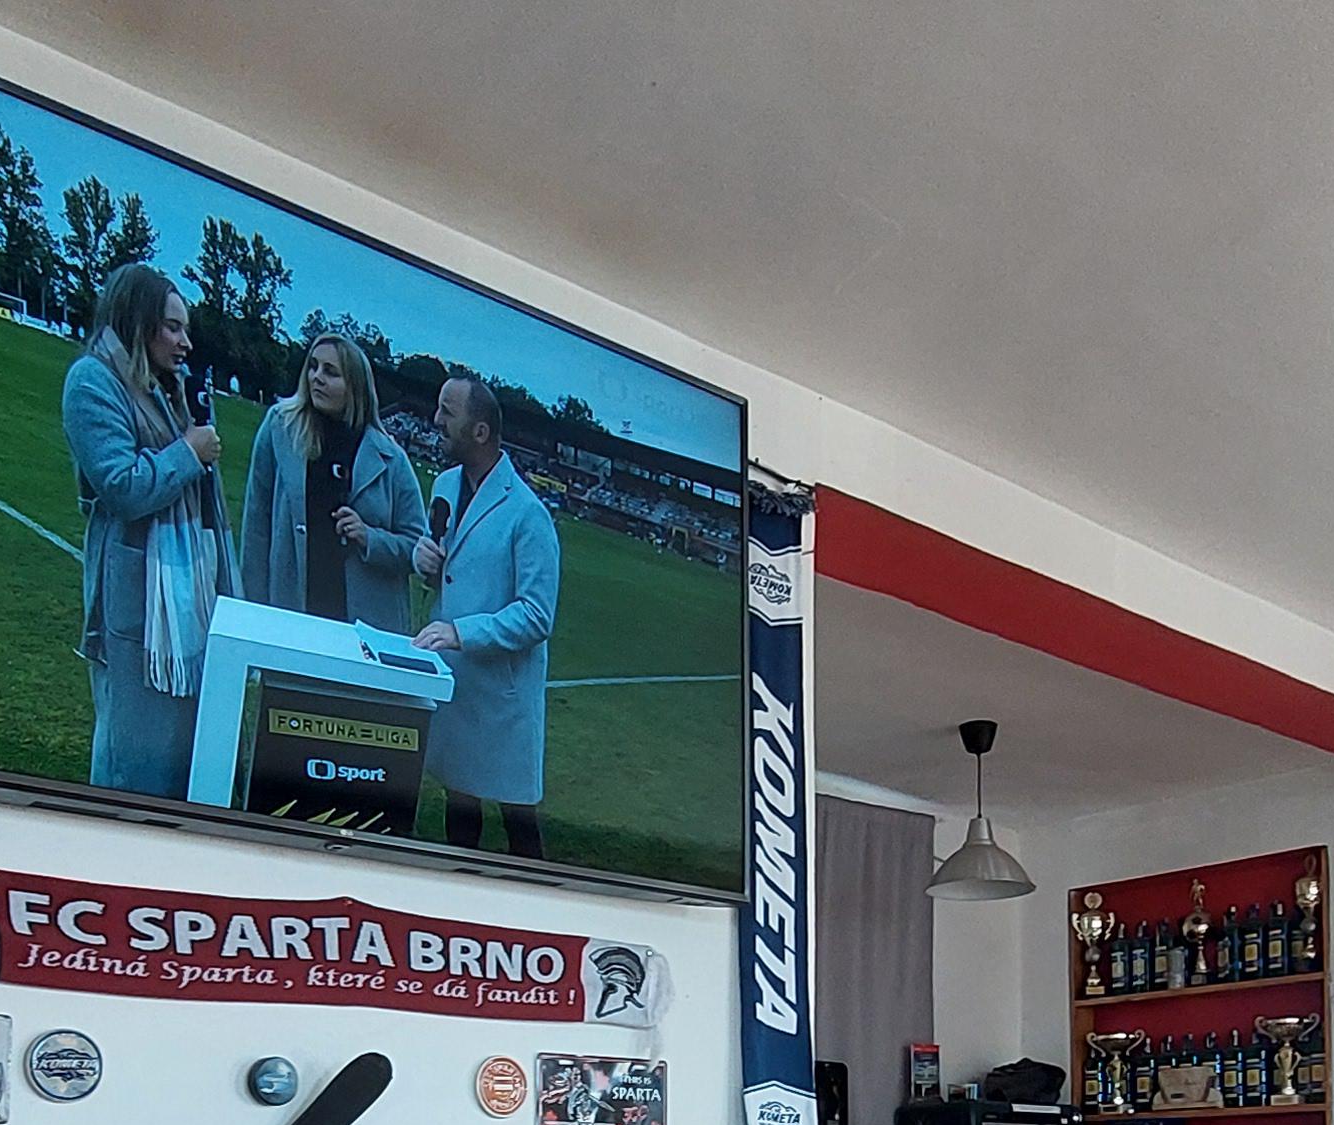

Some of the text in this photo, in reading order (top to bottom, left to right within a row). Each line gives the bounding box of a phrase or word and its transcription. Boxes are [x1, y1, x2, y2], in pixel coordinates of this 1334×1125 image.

[337, 765, 387, 781] sport
[751, 671, 799, 1037] KOMETA
[7, 889, 565, 983] FC SPARTA BRNO
[17, 943, 151, 978] Jediná
[159, 960, 279, 989] Sparta
[306, 964, 386, 990] které
[394, 978, 423, 994] se
[433, 978, 470, 999] dá
[474, 982, 560, 1007] fandit
[612, 1086, 662, 1102] SPARTA
